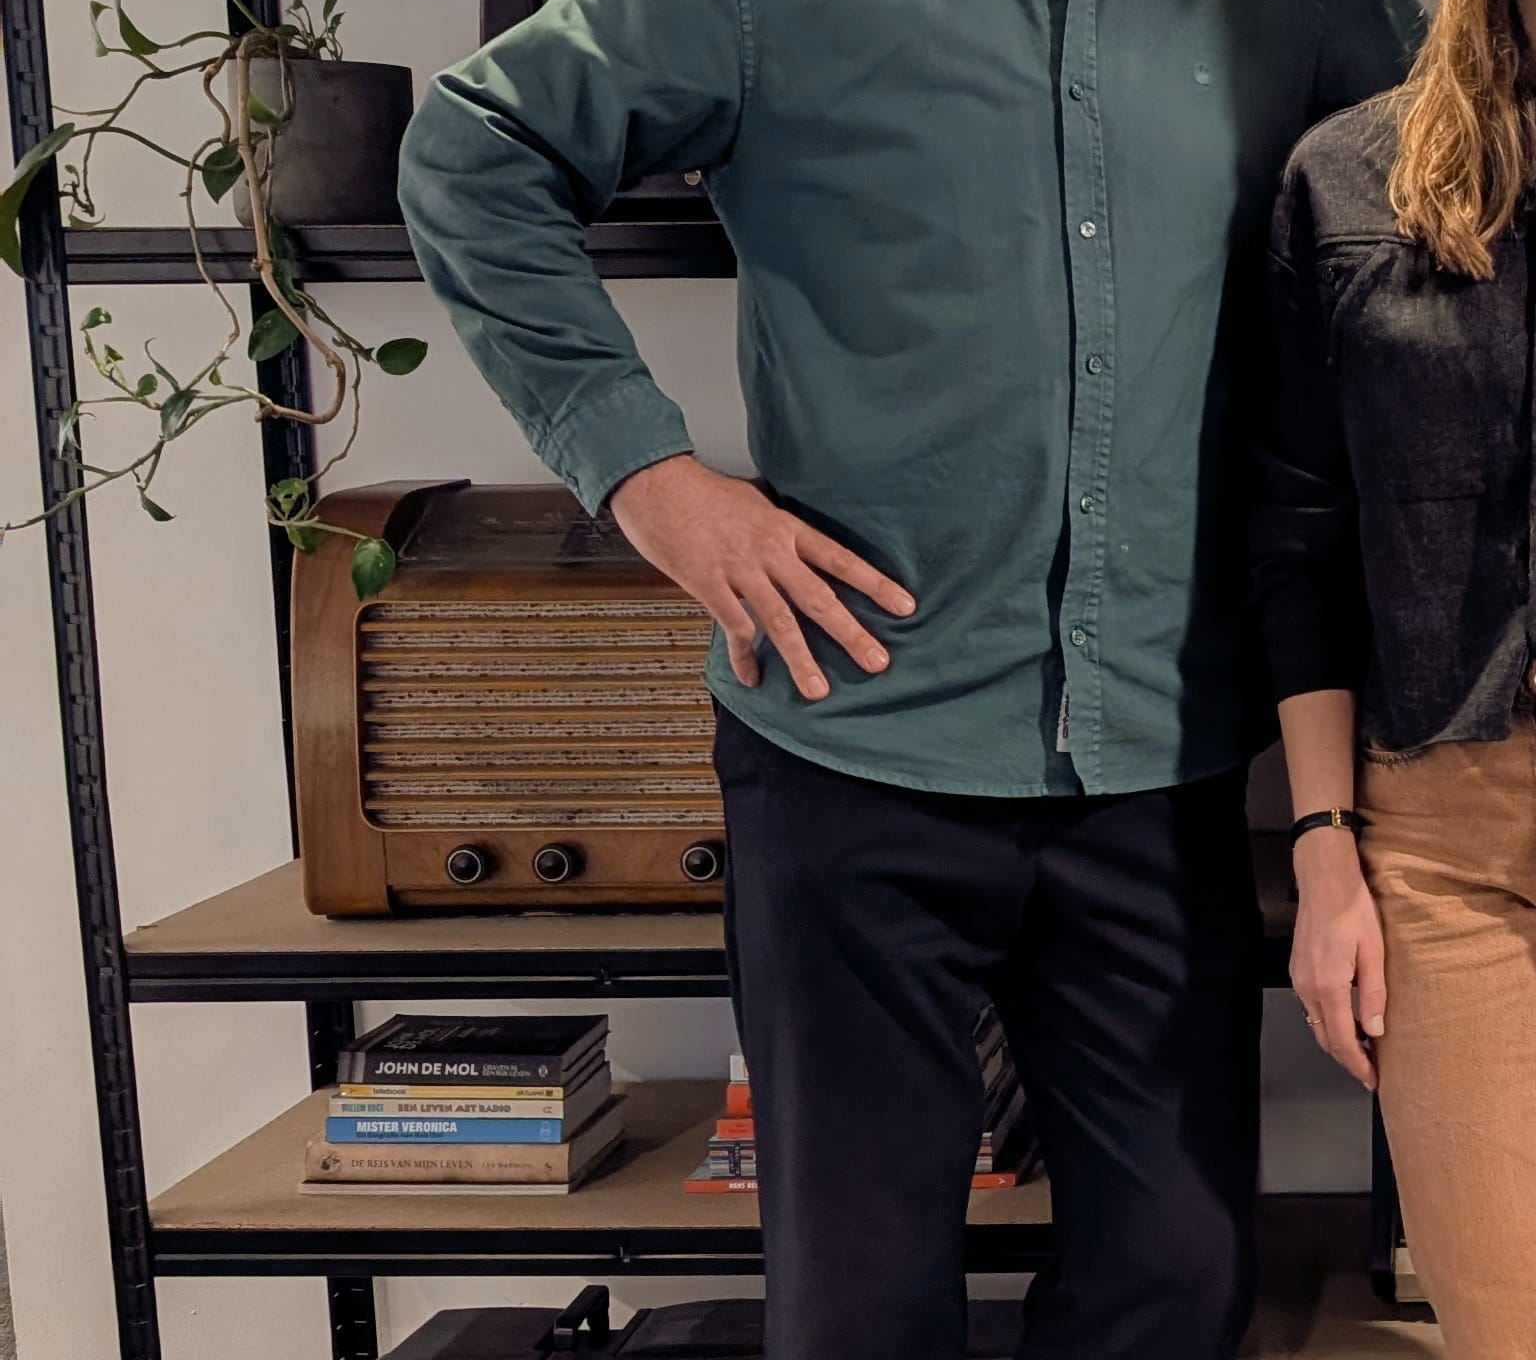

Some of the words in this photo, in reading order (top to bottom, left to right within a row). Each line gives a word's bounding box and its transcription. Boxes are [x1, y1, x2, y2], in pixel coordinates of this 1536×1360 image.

[375, 1061, 418, 1075] JOHN
[421, 1062, 443, 1075] DE
[444, 1062, 479, 1076] MOL
[420, 1104, 453, 1112] LEVEN
[479, 1104, 512, 1113] RADIO
[356, 1121, 399, 1132] MISTER
[401, 1121, 458, 1133] VERONICA
[351, 1159, 365, 1168] DE
[367, 1159, 389, 1169] REIS
[390, 1159, 412, 1169] VAN
[413, 1159, 438, 1170] MIJN
[440, 1159, 473, 1169] LEVEN
